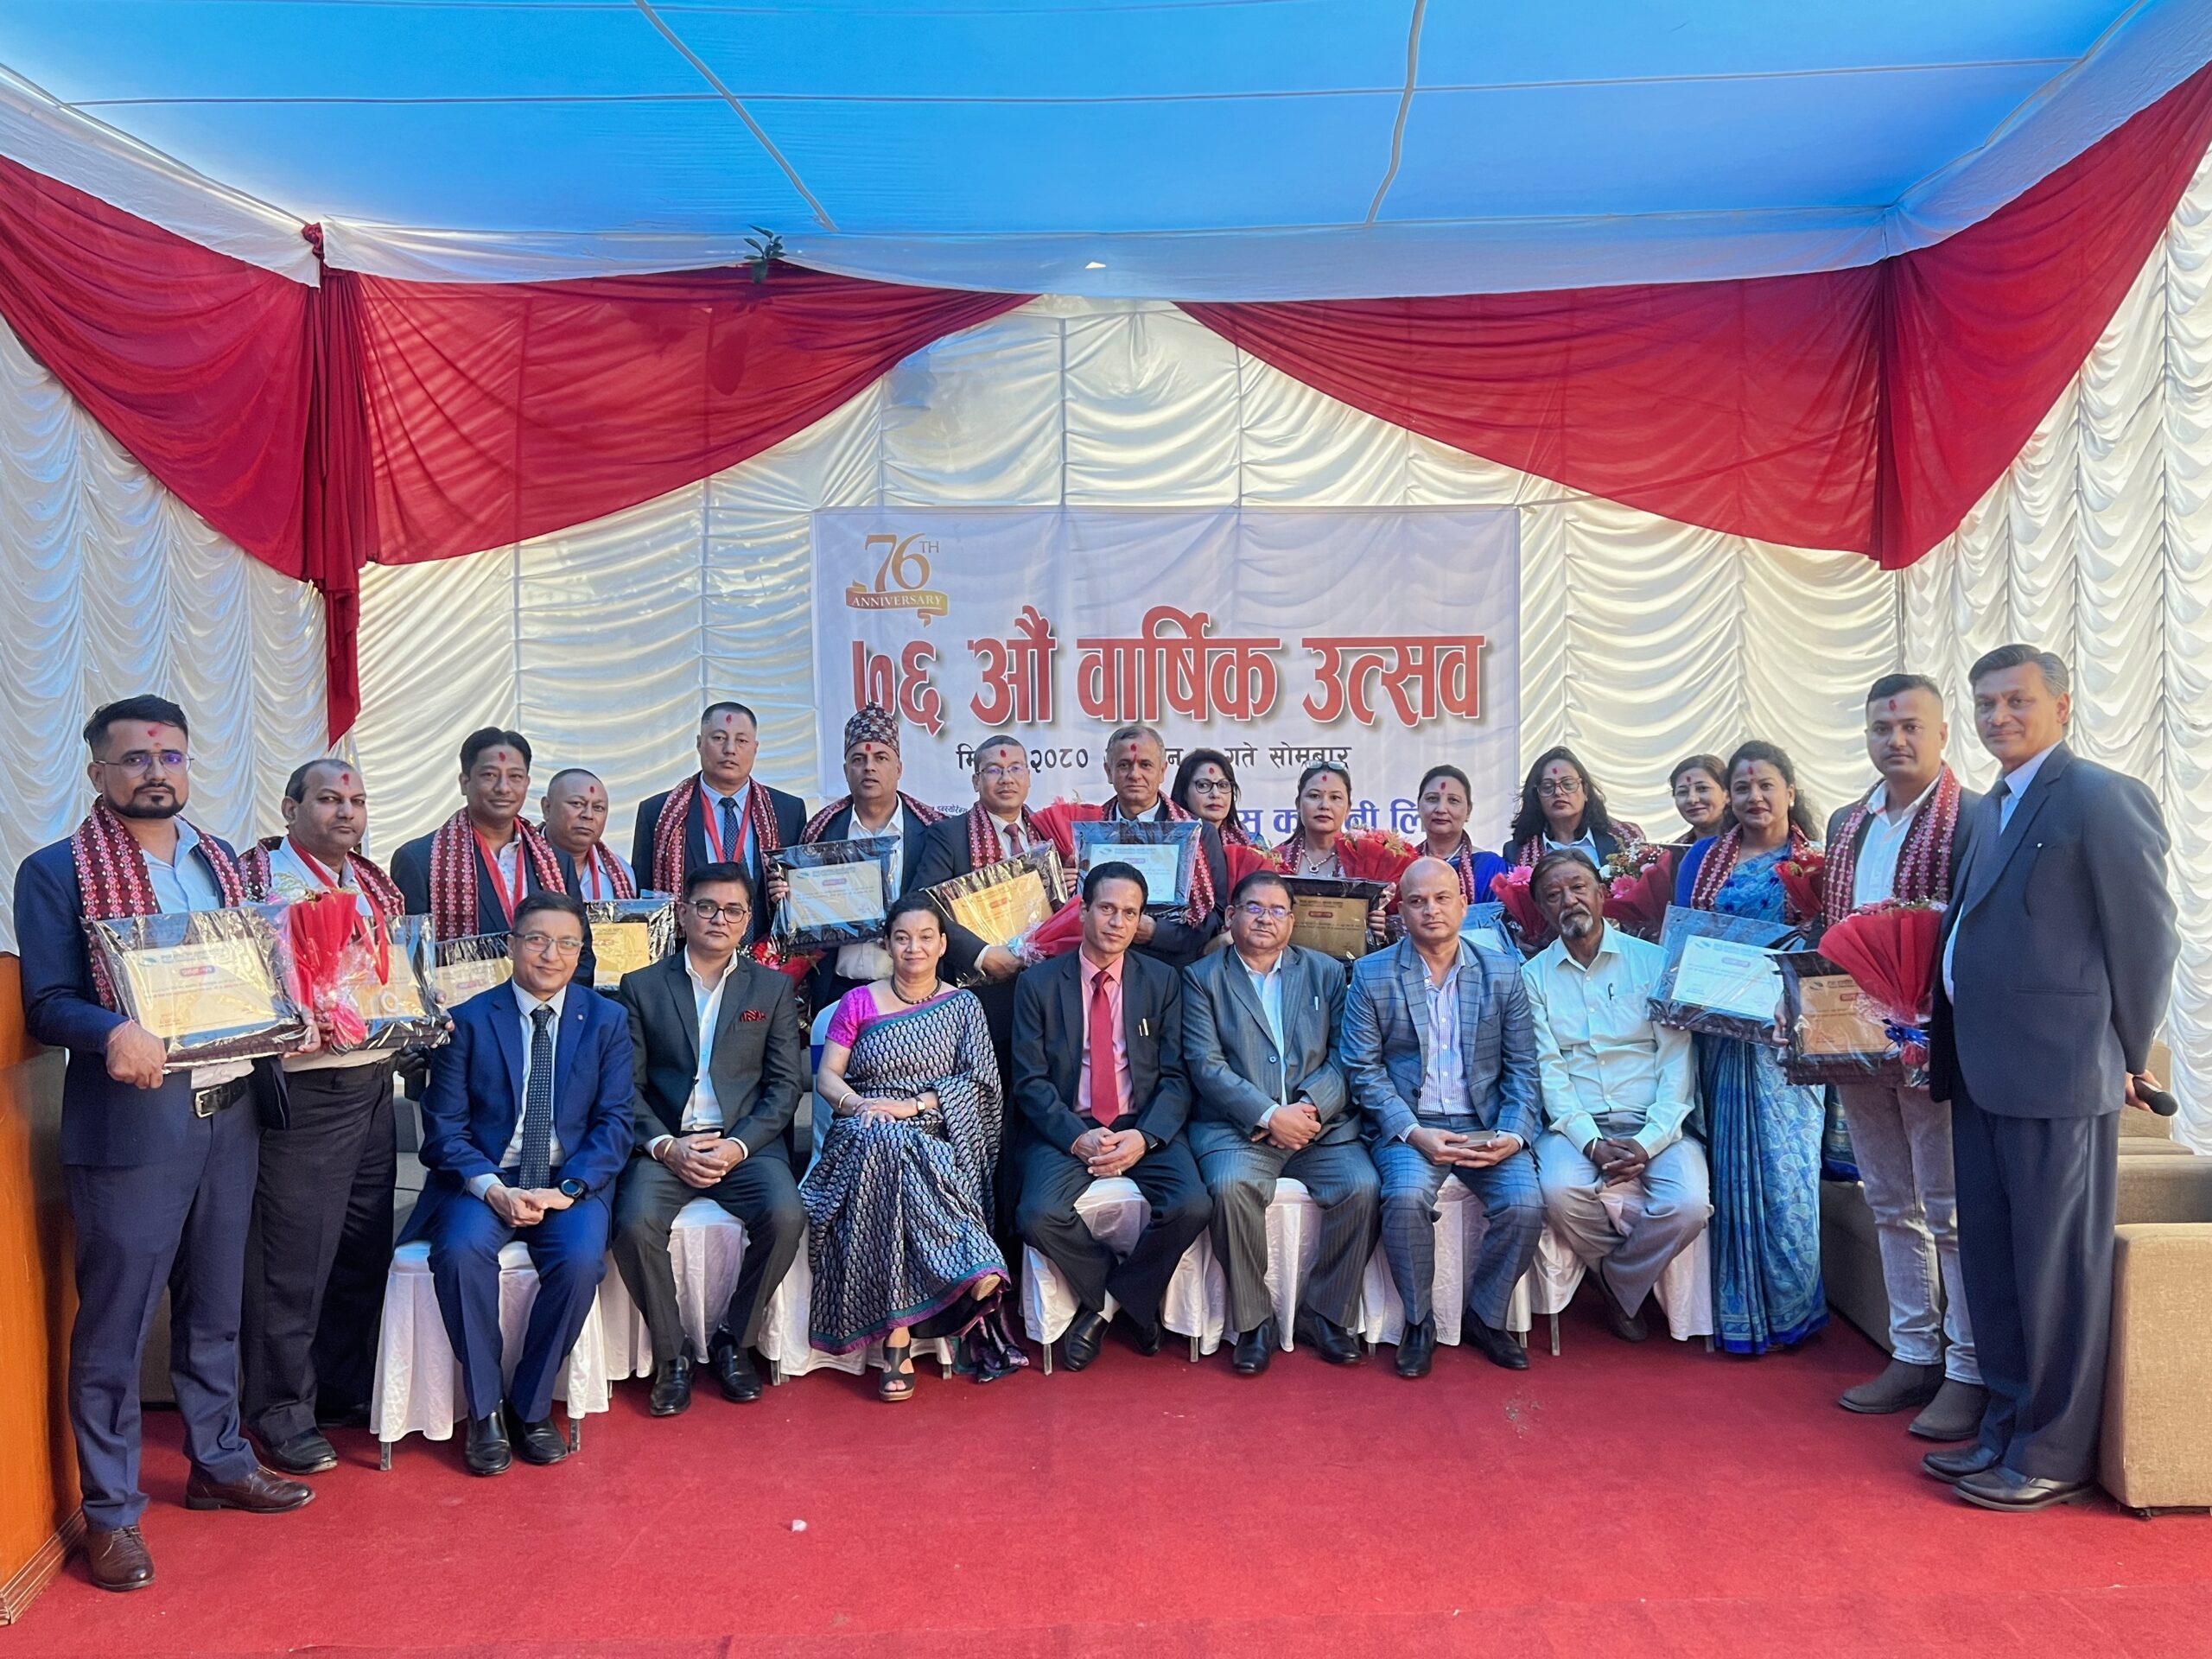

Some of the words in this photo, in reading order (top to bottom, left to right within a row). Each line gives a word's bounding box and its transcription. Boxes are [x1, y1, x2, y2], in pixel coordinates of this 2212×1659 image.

[851, 594, 943, 607] ANNIVERSARY
[852, 639, 945, 736] ७६
[1077, 605, 1282, 722] वार्षिक
[1301, 635, 1486, 728] उत्सव
[1030, 748, 1089, 773] २०८०
